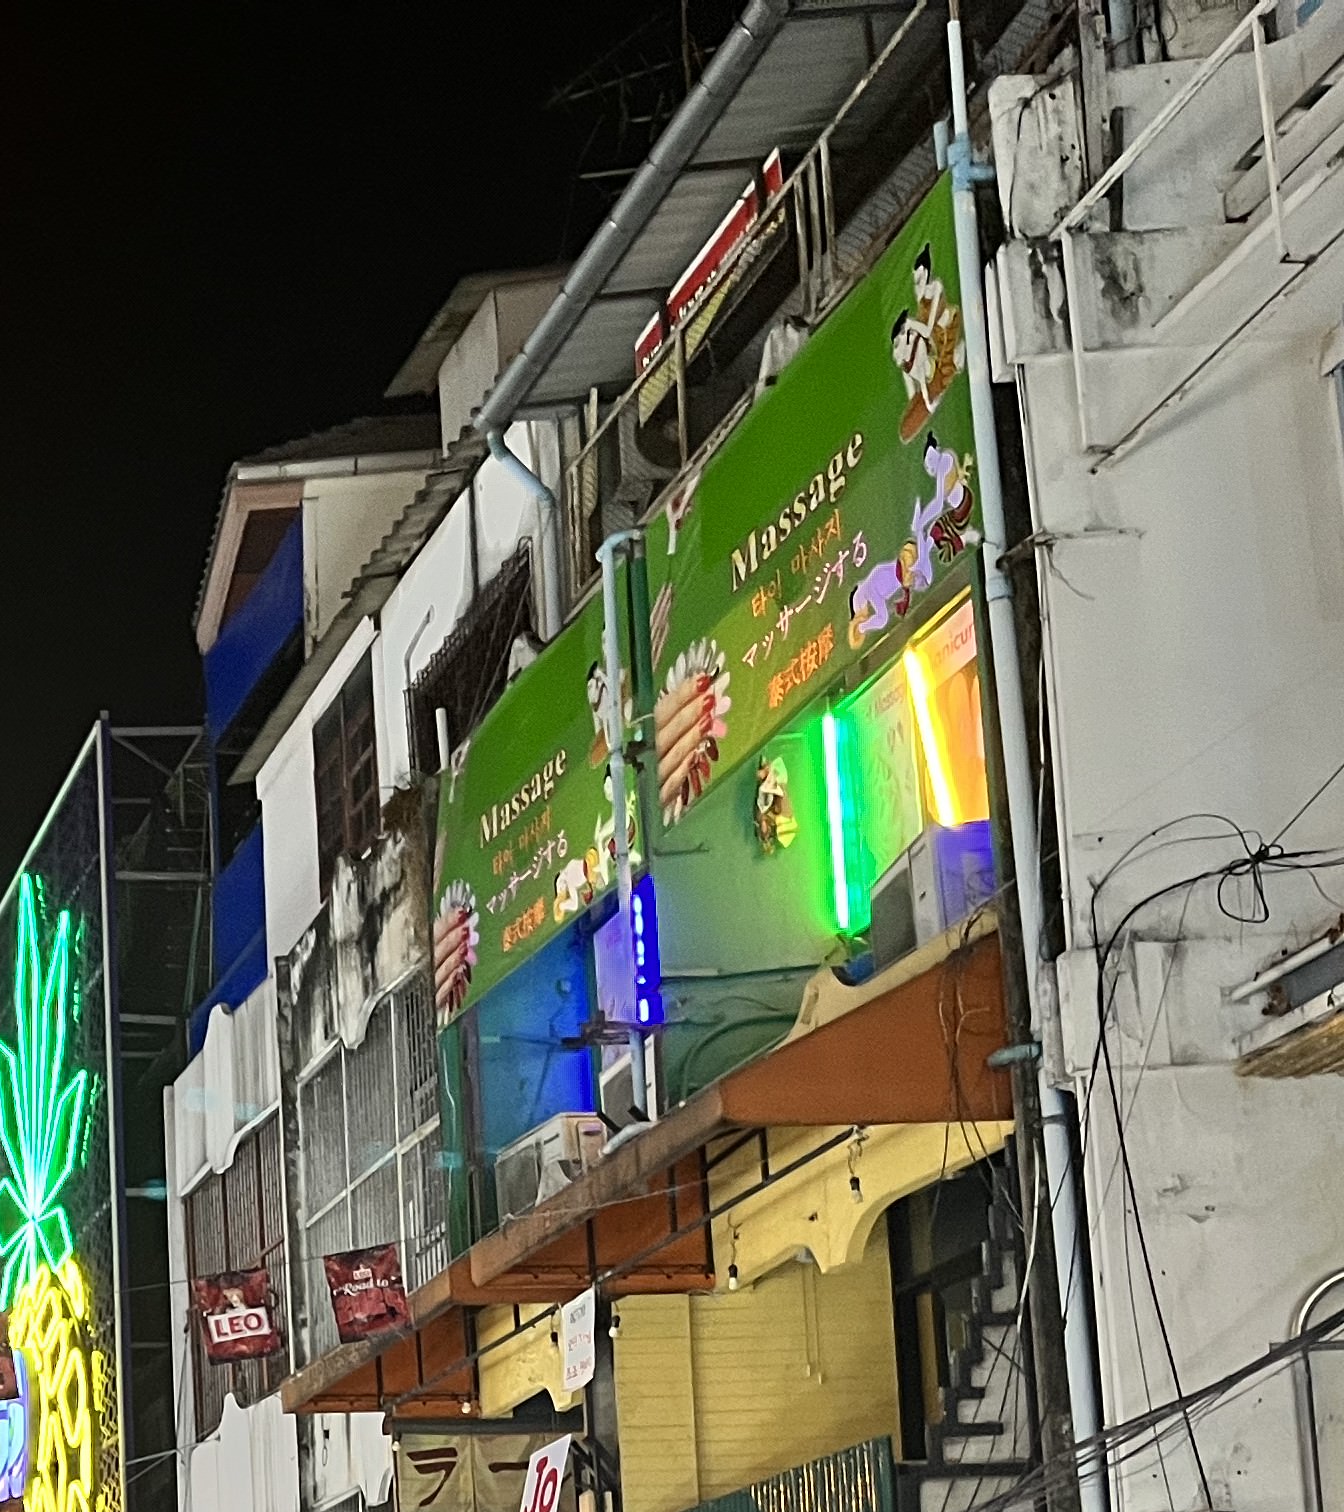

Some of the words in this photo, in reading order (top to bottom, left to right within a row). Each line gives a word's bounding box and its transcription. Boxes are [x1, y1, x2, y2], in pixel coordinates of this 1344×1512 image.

[730, 432, 864, 593] Massage
[479, 749, 567, 849] Massage
[342, 1277, 374, 1295] Road
[376, 1278, 390, 1288] to
[214, 1312, 264, 1339] LEO
